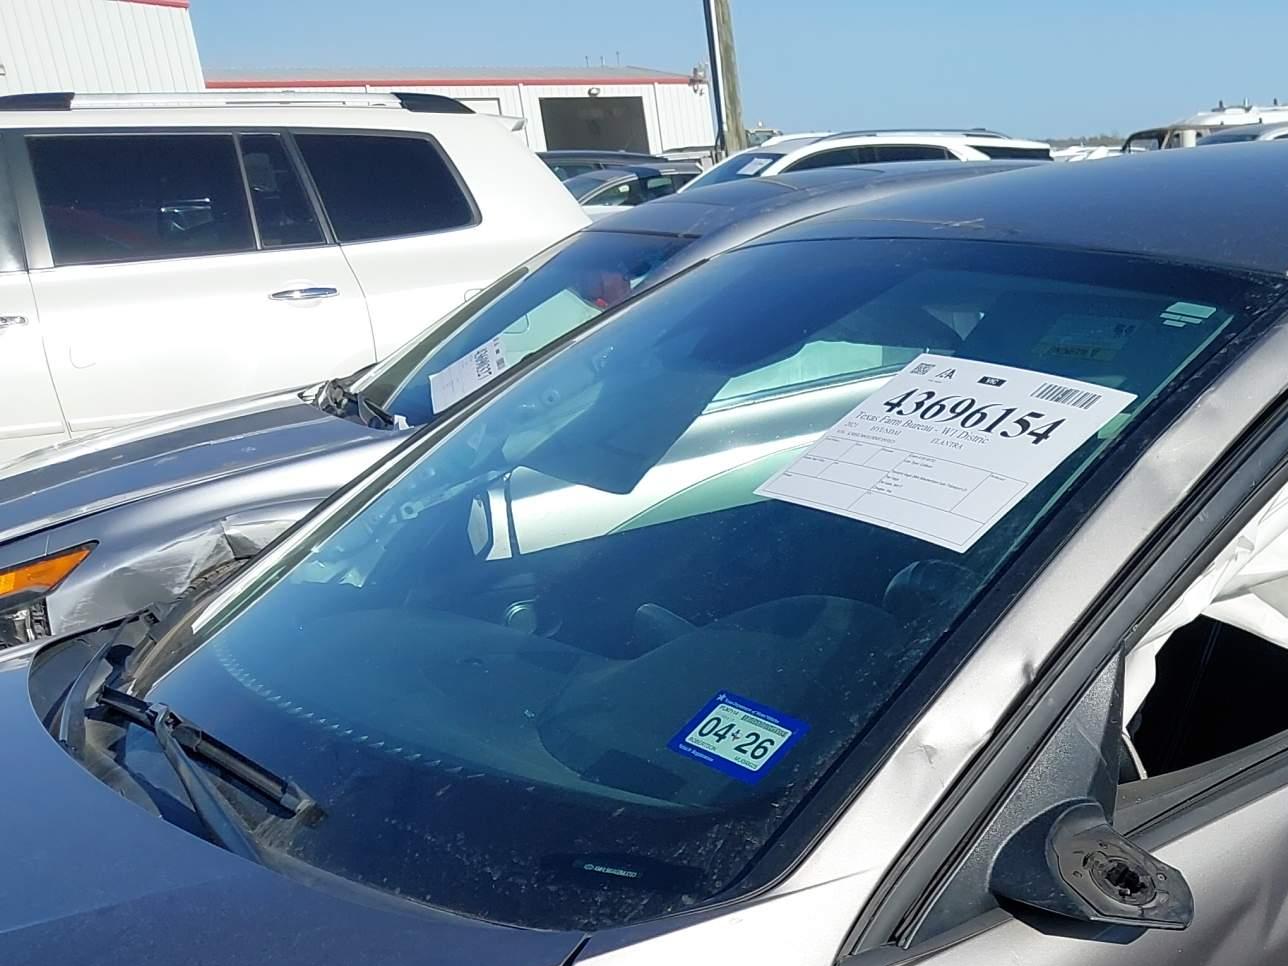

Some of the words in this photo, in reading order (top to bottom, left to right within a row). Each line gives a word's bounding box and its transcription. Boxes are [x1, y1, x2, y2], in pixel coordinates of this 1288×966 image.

[855, 411, 881, 423] Texas
[903, 418, 935, 433] Bureau
[883, 388, 1066, 445] 43696154
